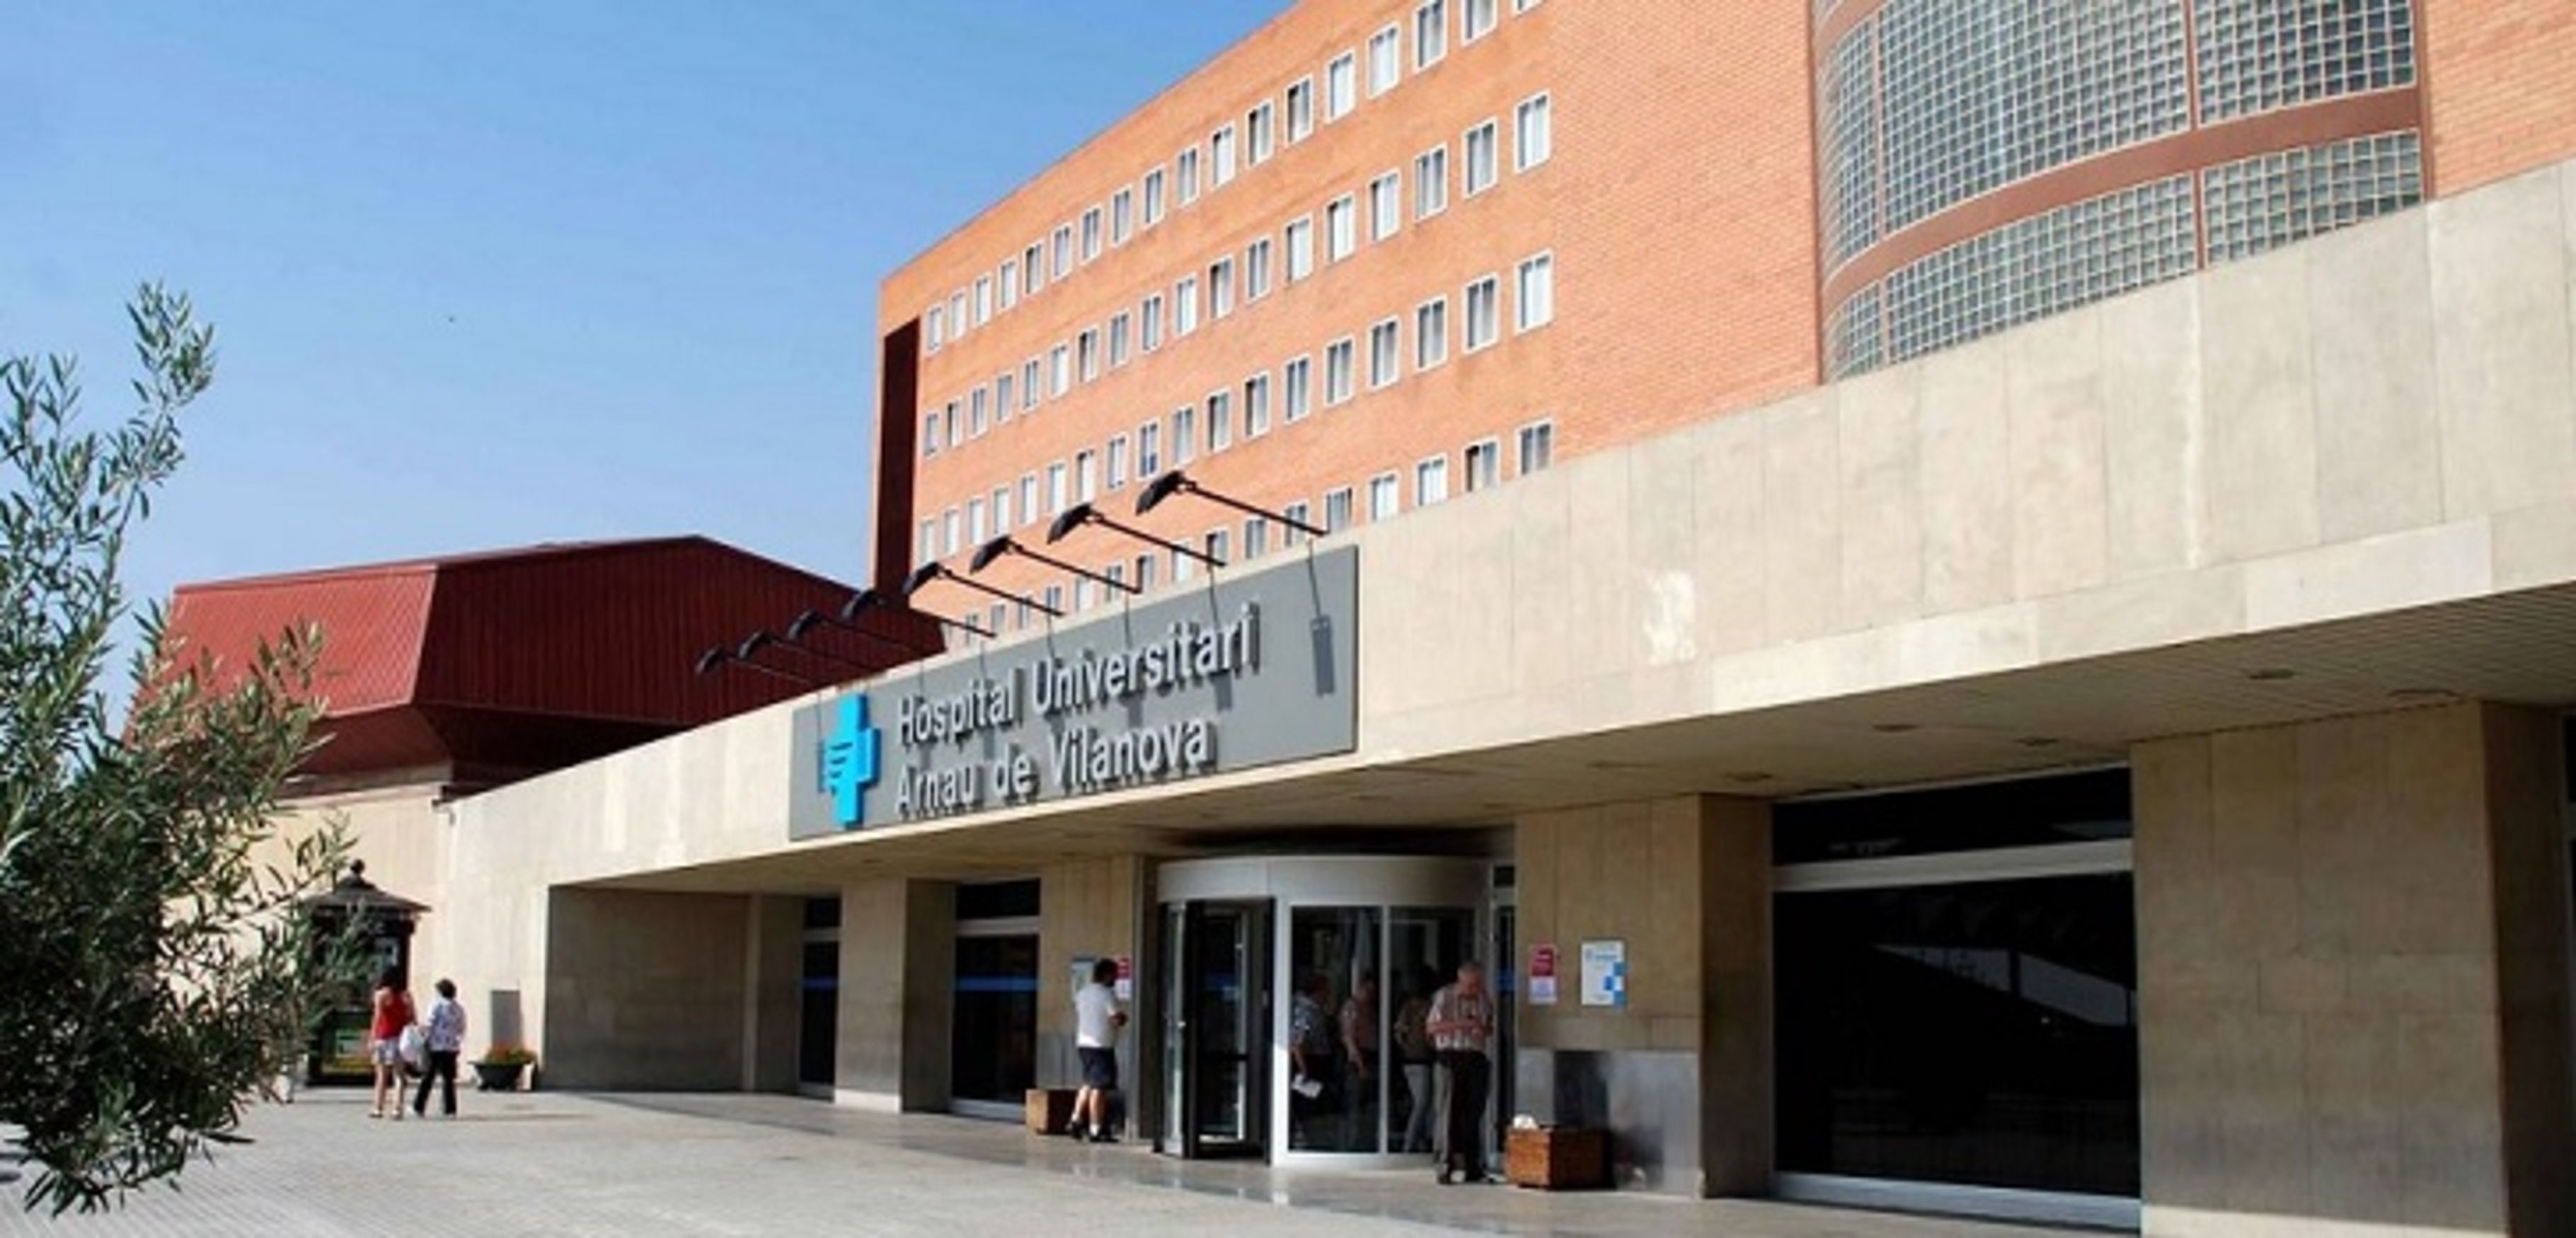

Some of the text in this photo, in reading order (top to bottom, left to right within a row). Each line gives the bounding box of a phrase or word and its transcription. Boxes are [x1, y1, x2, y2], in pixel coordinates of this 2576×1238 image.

[898, 601, 1250, 746] Hospital Universitari
[896, 717, 1209, 812] Arnau de Vilanova
